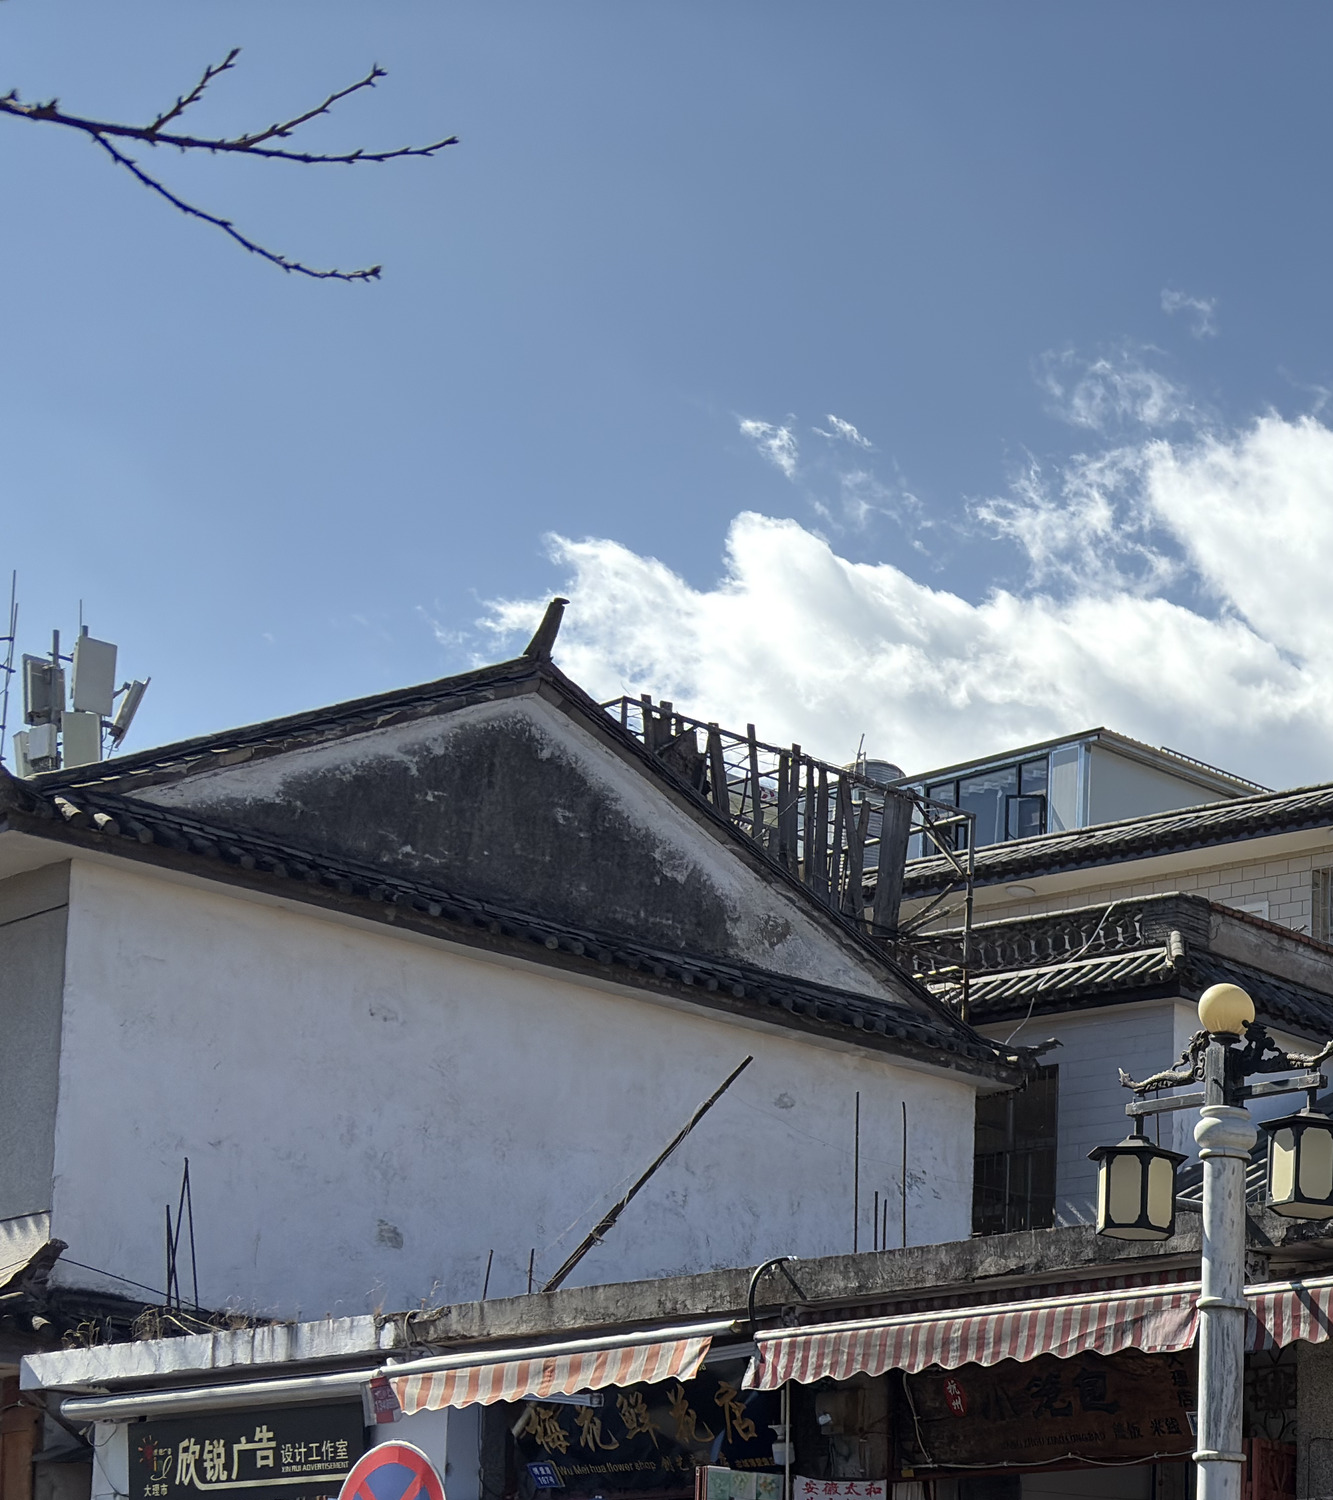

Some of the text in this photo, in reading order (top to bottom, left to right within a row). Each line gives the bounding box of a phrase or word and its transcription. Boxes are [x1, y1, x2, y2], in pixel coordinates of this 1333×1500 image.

[175, 1425, 349, 1486] 欣锐广告 设计工作室
[143, 1484, 169, 1497] 大理市
[802, 1480, 882, 1497] 安徽太和
